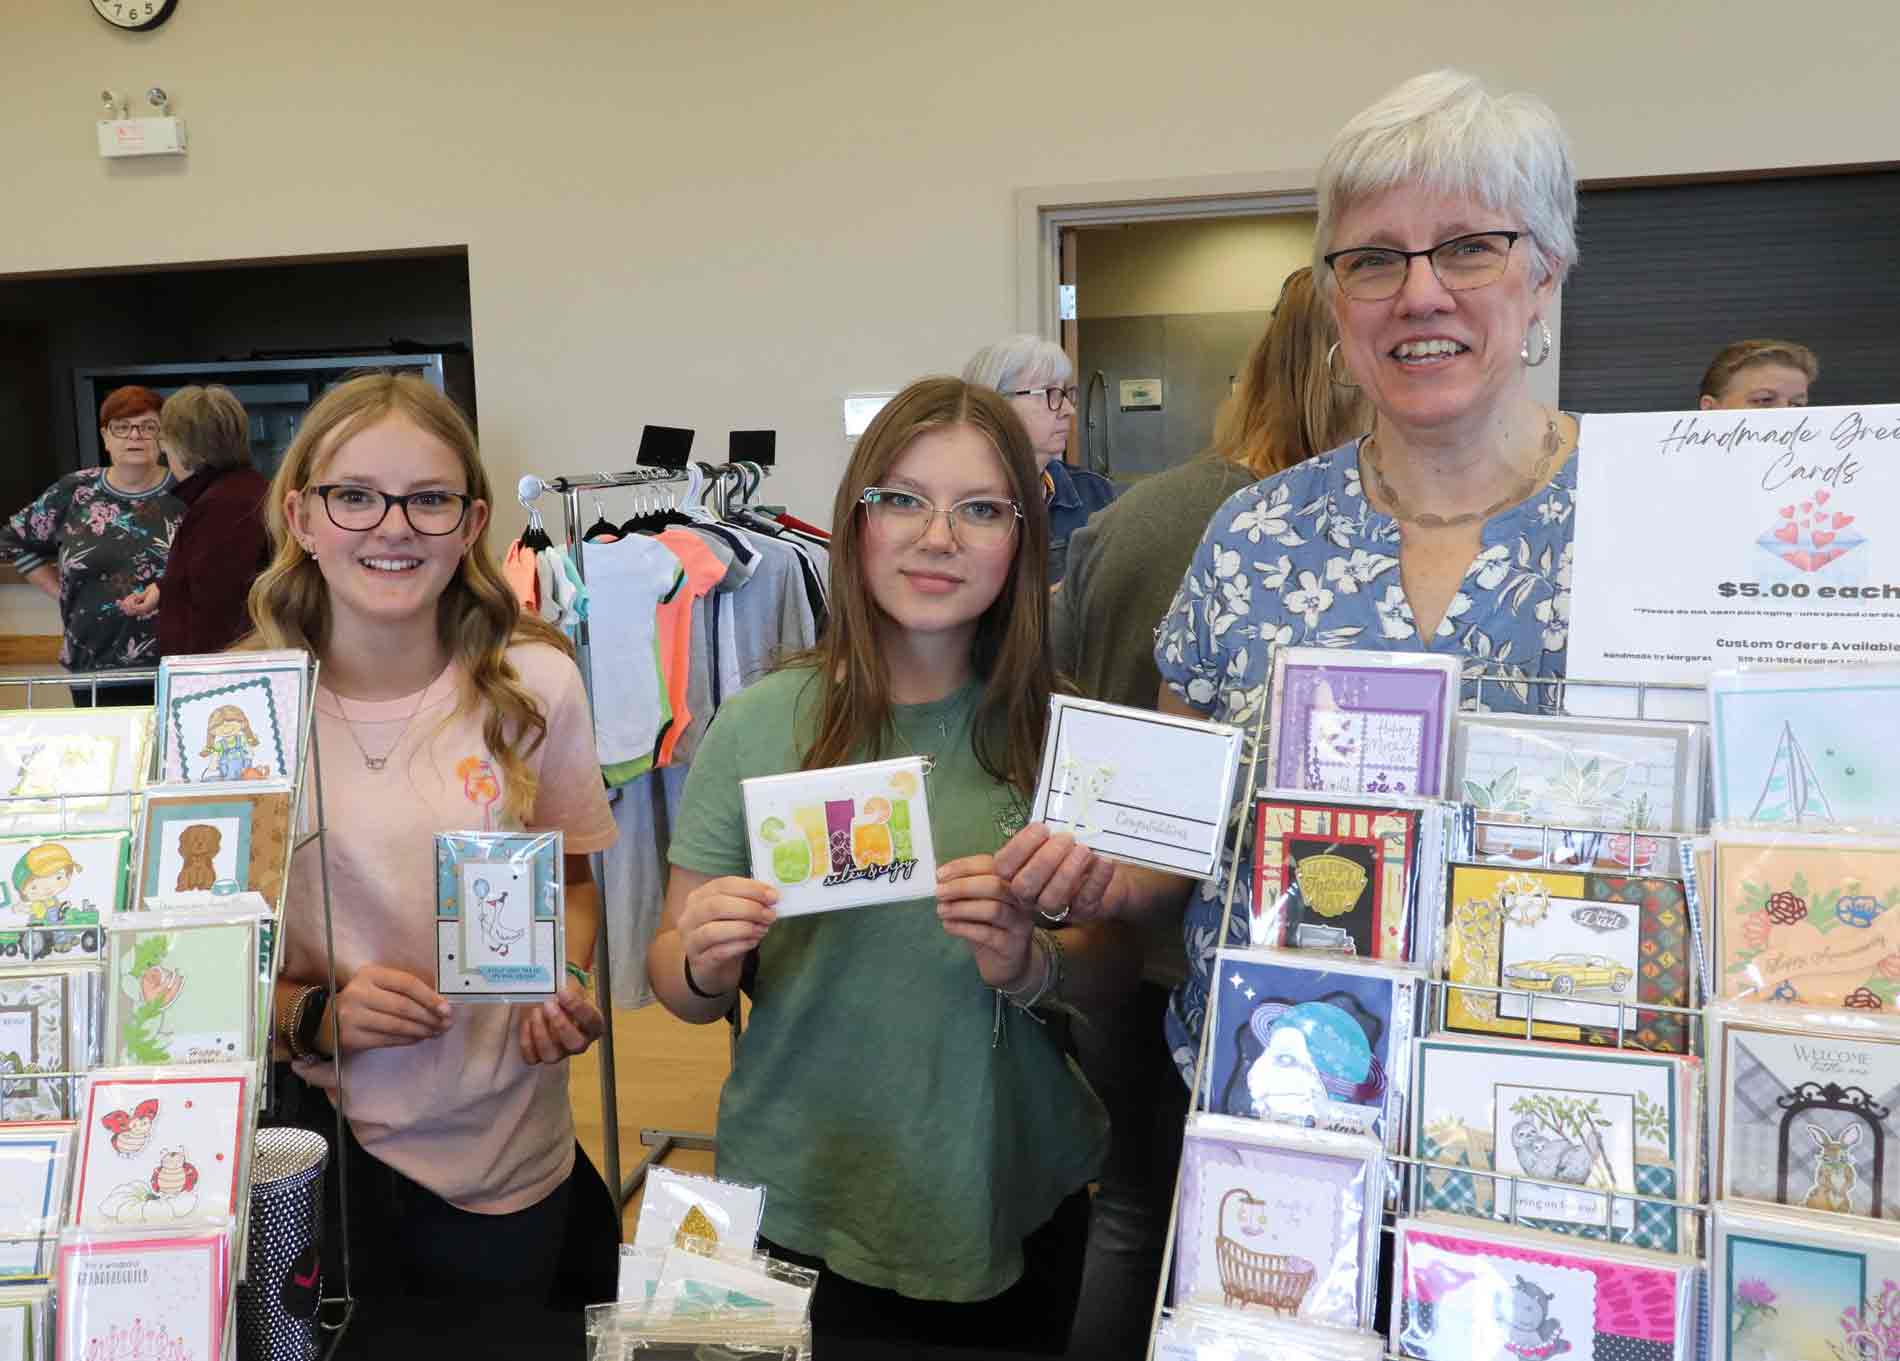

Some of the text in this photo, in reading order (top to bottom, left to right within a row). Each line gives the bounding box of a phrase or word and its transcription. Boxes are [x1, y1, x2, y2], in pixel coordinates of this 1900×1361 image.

[113, 3, 122, 16] 7
[129, 8, 138, 20] 6
[145, 3, 153, 15] 5
[1659, 416, 1818, 454] Handmade
[1761, 451, 1864, 491] Cards
[1717, 581, 1900, 599] $5.00 each
[1716, 638, 1900, 652] Custom Orders Available
